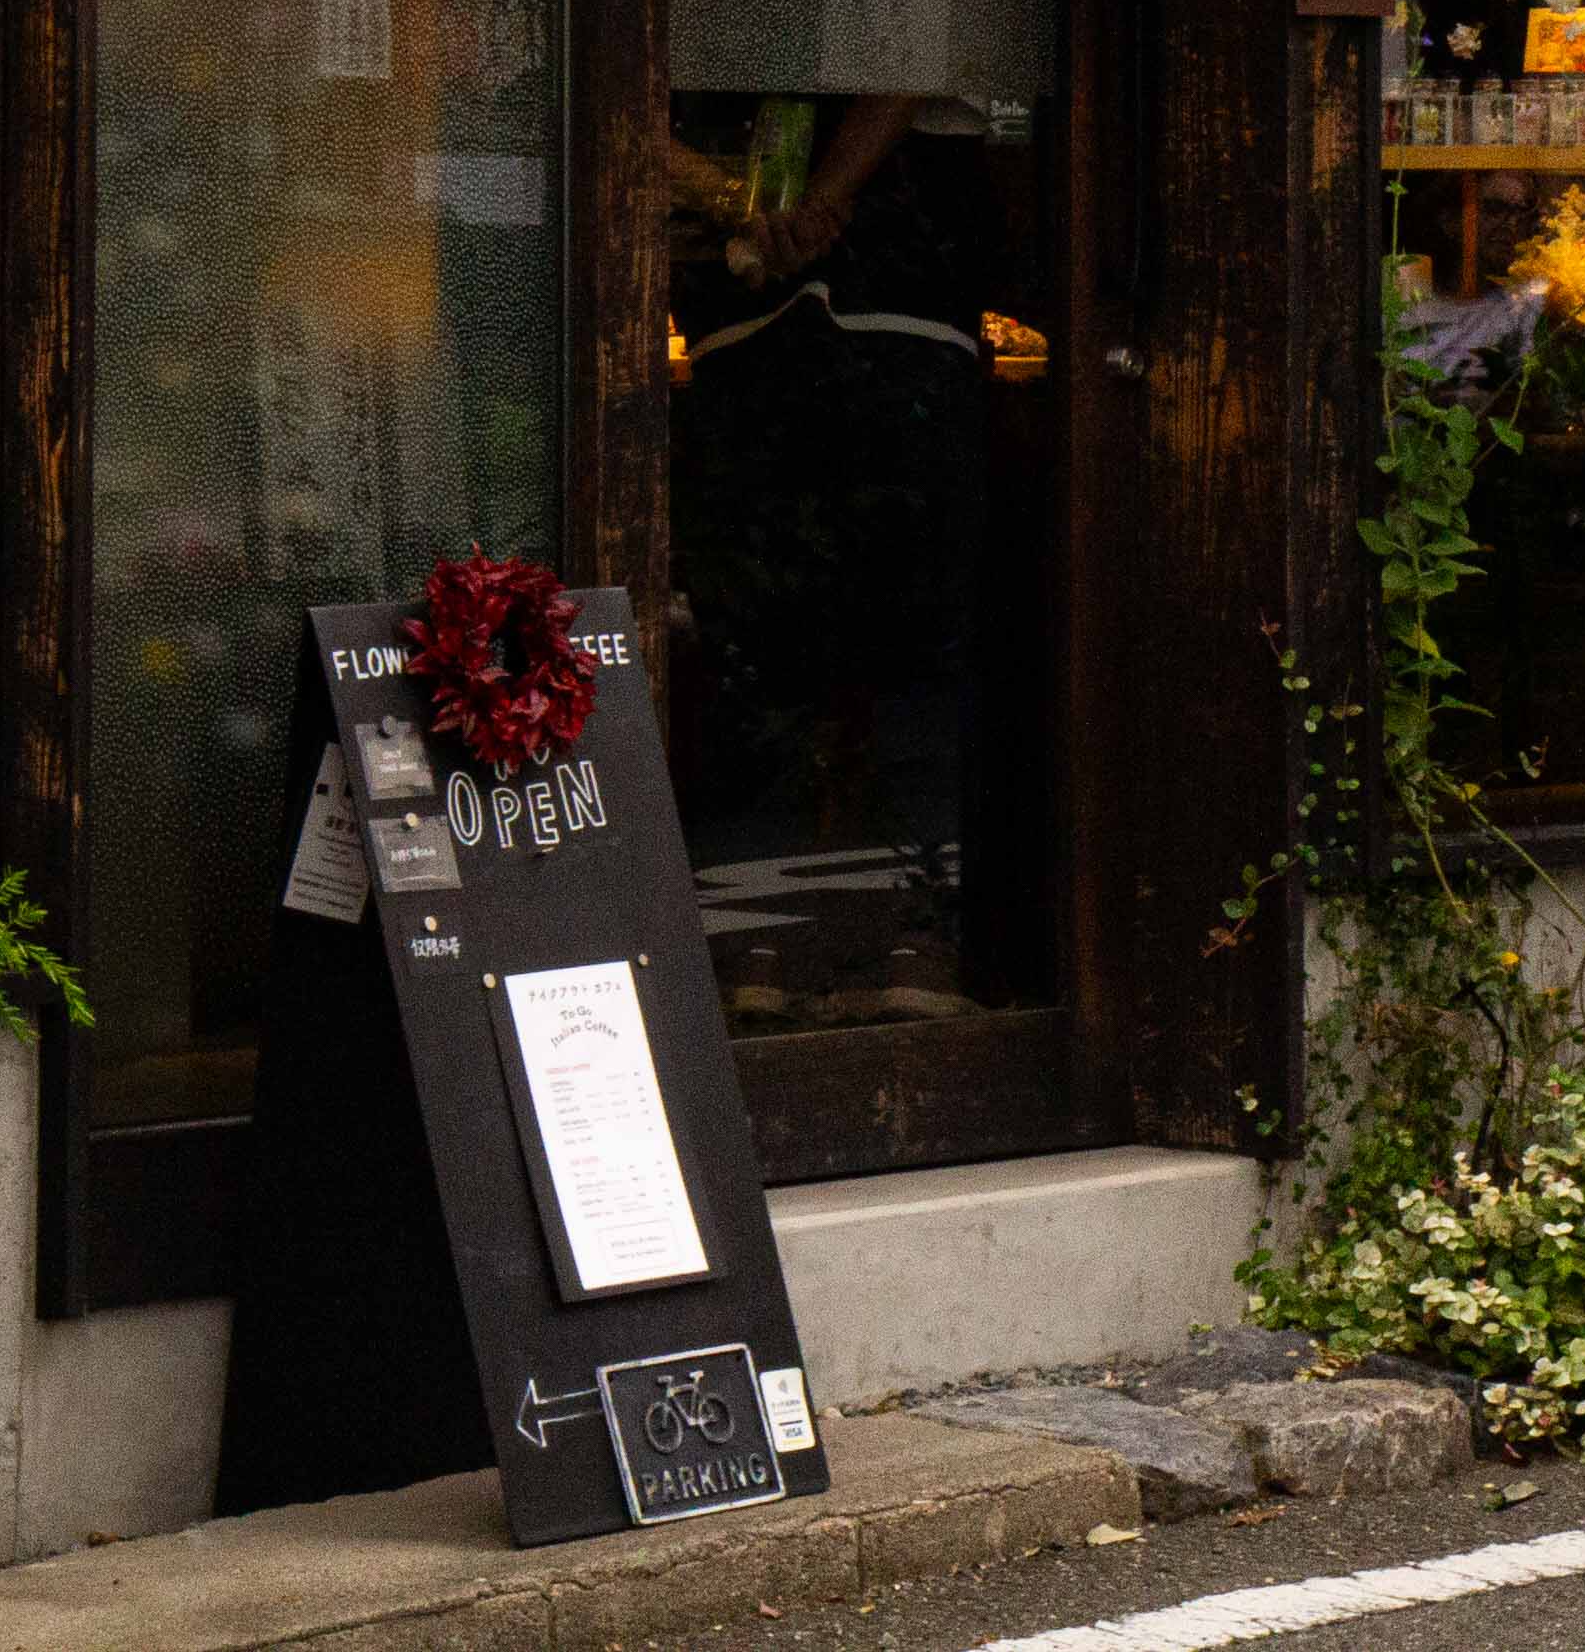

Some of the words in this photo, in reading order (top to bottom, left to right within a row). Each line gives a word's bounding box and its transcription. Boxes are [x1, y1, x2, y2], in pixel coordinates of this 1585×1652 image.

[332, 646, 409, 680] FLOW
[447, 760, 607, 849] OPEN
[641, 1452, 767, 1505] PARKING
